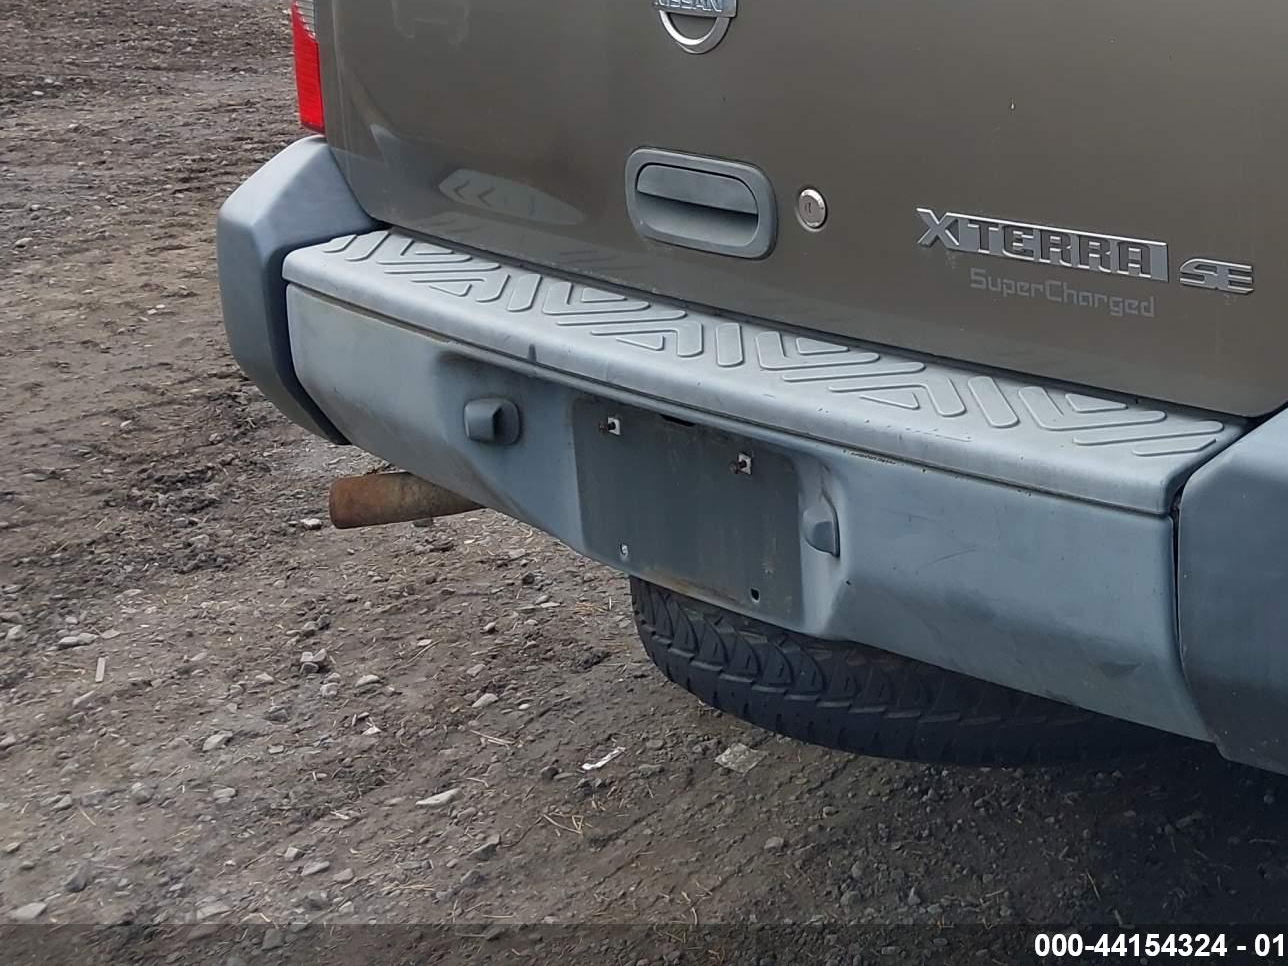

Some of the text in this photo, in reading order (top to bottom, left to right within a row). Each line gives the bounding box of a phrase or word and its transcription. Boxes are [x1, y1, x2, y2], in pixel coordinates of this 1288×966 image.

[915, 207, 1254, 294] XTERRA SE
[969, 267, 1154, 318] SuperCharged
